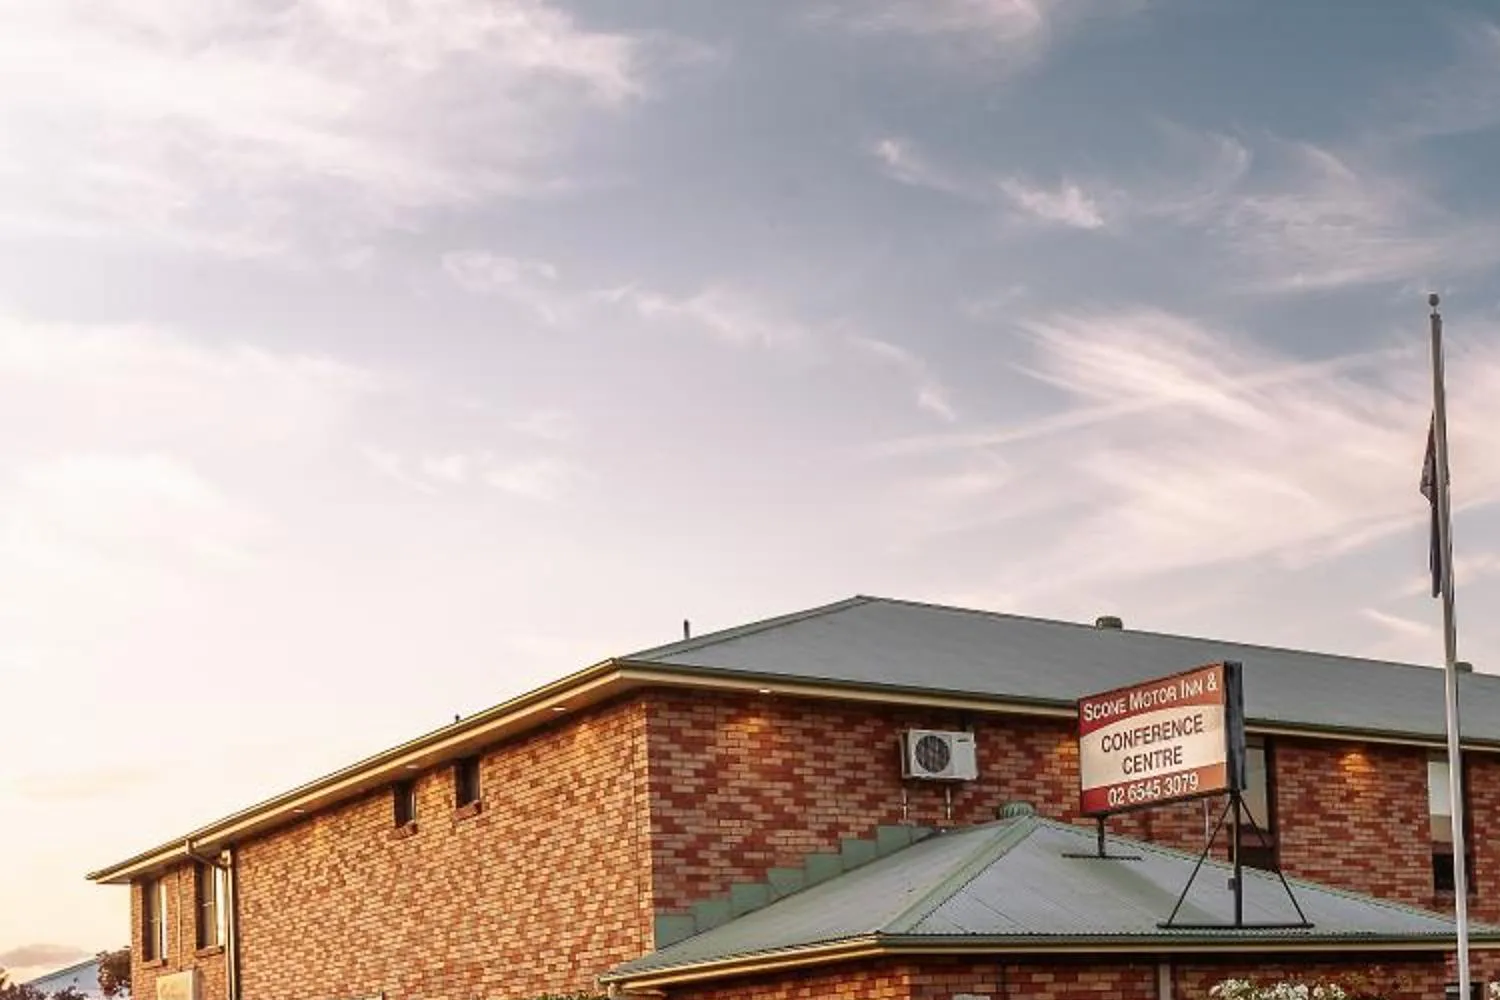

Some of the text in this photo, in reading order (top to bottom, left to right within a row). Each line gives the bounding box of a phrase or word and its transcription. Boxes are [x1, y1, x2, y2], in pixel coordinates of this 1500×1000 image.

[1083, 697, 1127, 722] SCONE
[1129, 685, 1177, 711] MOTOR
[1181, 679, 1203, 699] INN
[1101, 713, 1204, 753] CONFERENCE
[1122, 746, 1183, 775] CENTRE
[1108, 771, 1199, 806] 02 6545 3079
